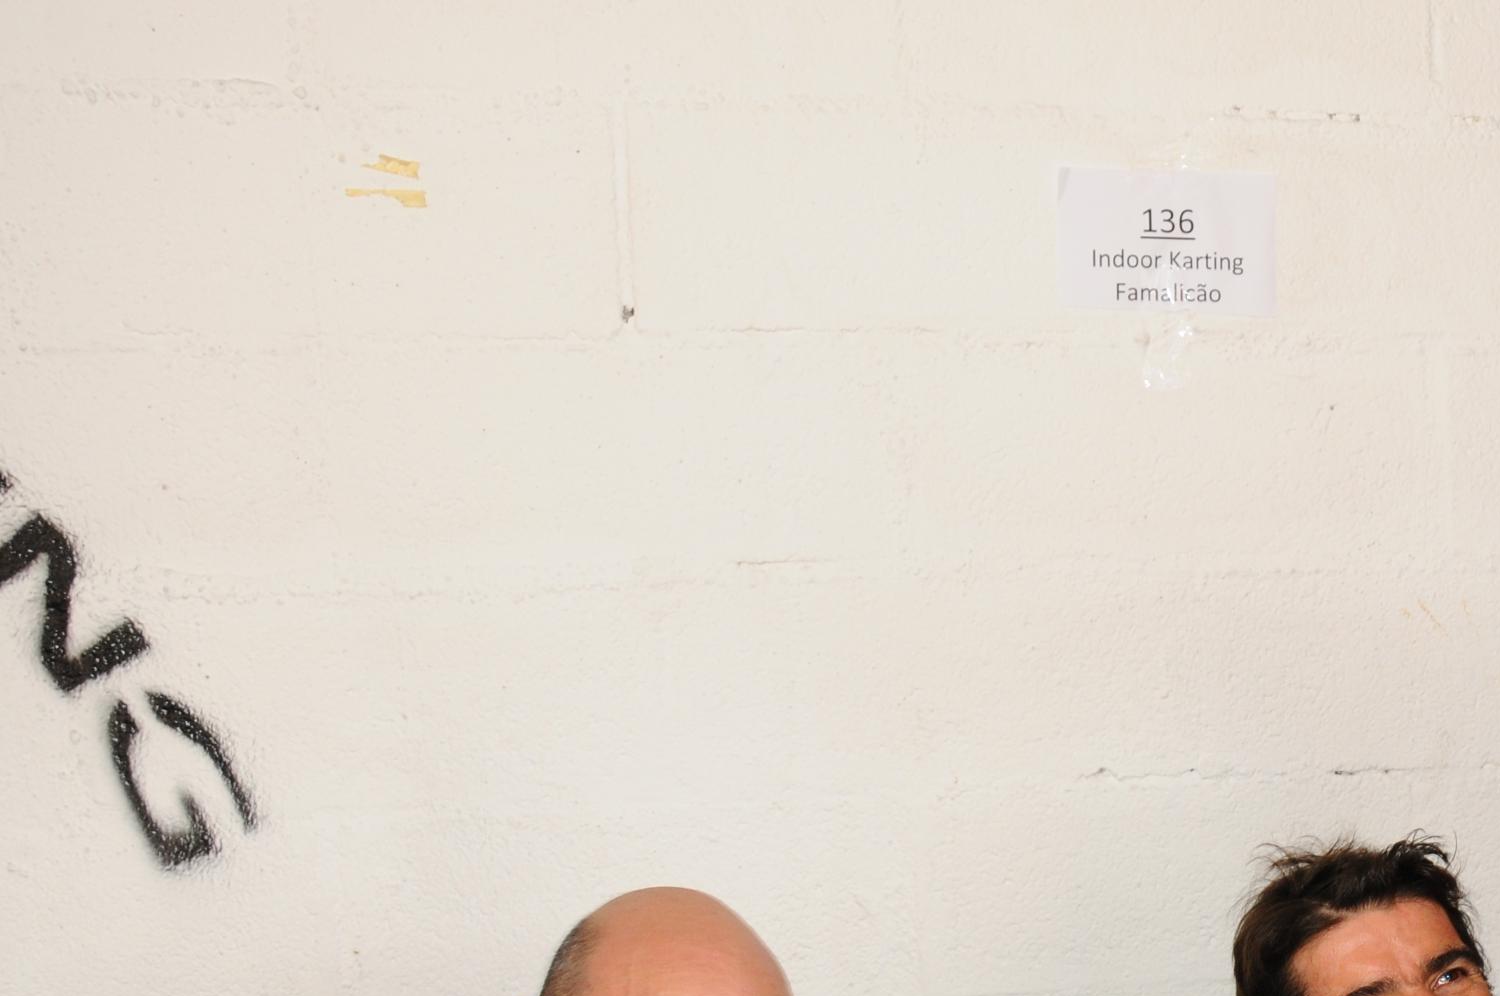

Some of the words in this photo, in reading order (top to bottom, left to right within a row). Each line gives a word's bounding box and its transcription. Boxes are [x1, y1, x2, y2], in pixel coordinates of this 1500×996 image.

[1142, 208, 1195, 235] 136
[1091, 249, 1162, 269] Indoor
[1169, 250, 1244, 276] Karting
[1115, 282, 1222, 303] Famalicão
